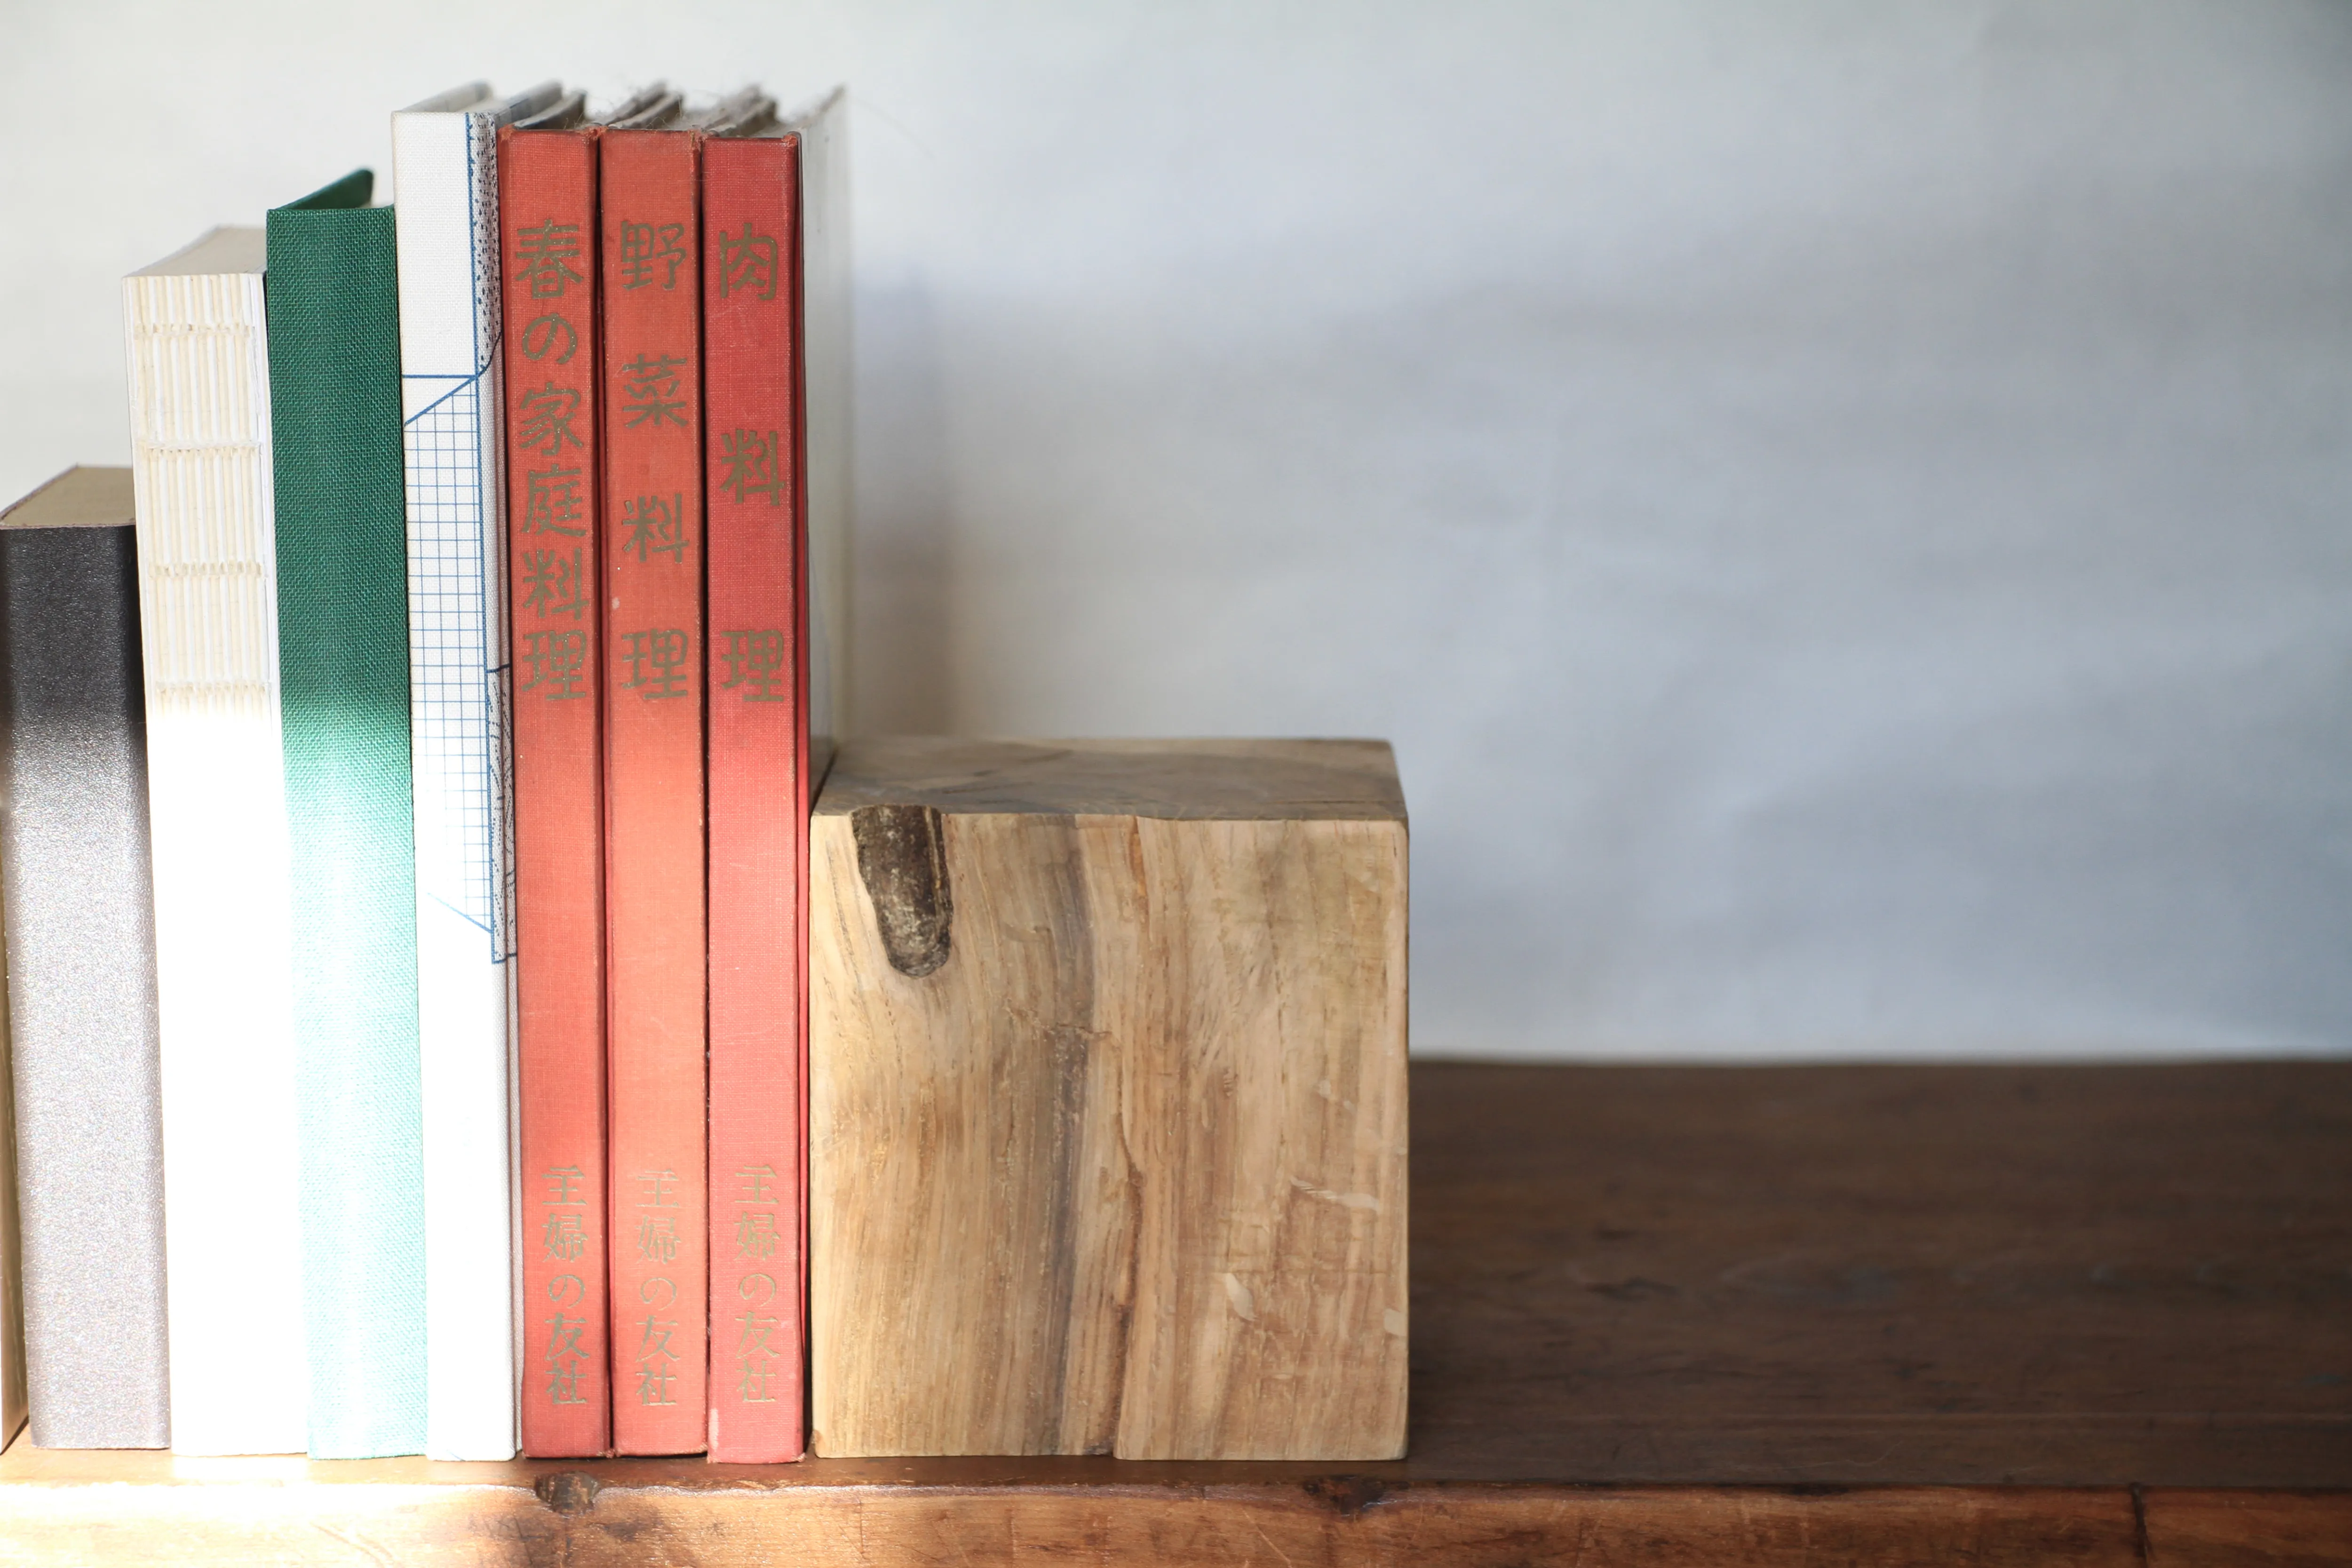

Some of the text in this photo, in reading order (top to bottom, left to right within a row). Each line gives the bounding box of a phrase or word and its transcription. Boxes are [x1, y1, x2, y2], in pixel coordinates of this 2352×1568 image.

[515, 219, 590, 700] 春の家庭料理
[620, 221, 690, 700] 野菜料理
[718, 222, 785, 702] 肉料理
[541, 1164, 590, 1405] 主婦の友社
[636, 1168, 682, 1406] 主婦の友社
[733, 1164, 781, 1403] 主婦の友社
